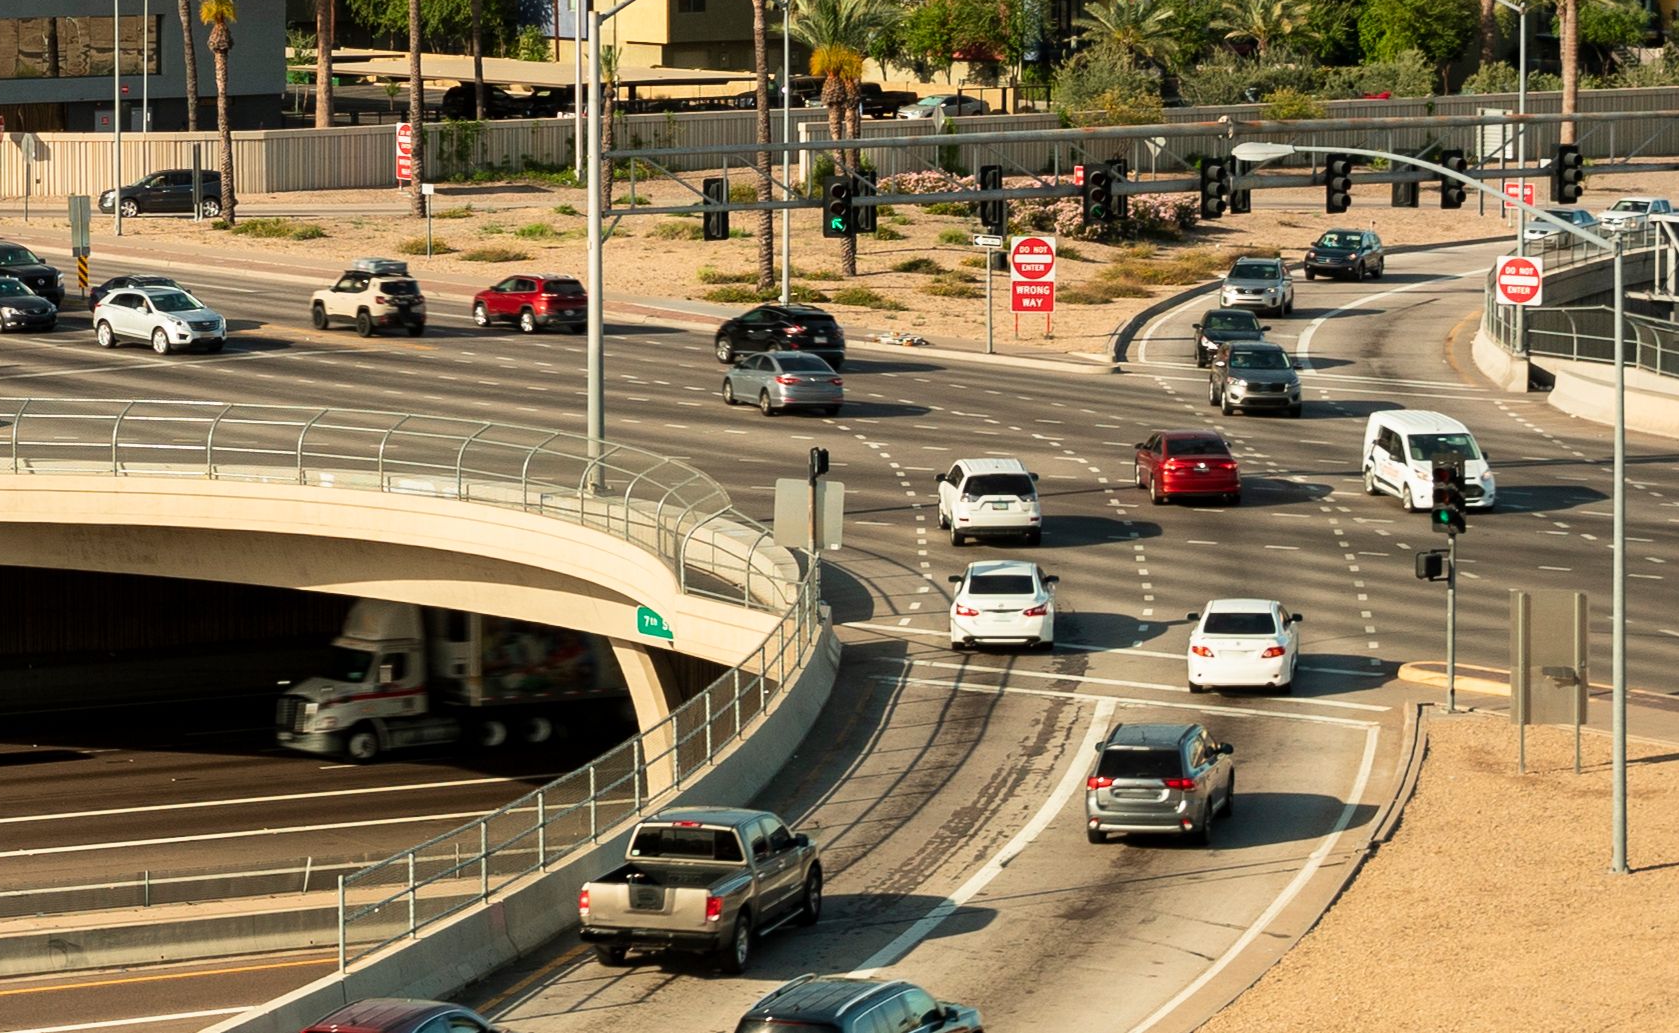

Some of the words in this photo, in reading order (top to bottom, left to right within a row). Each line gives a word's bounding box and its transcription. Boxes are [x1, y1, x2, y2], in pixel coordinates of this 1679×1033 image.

[1019, 246, 1030, 254] DO
[1033, 246, 1048, 254] NOT
[1021, 264, 1045, 272] ENTER
[1505, 266, 1516, 275] DO
[1519, 267, 1535, 275] NOT
[1016, 285, 1051, 296] WRONG
[1507, 286, 1531, 295] ENTER
[1021, 298, 1044, 308] WAY
[643, 615, 658, 627] 7th
